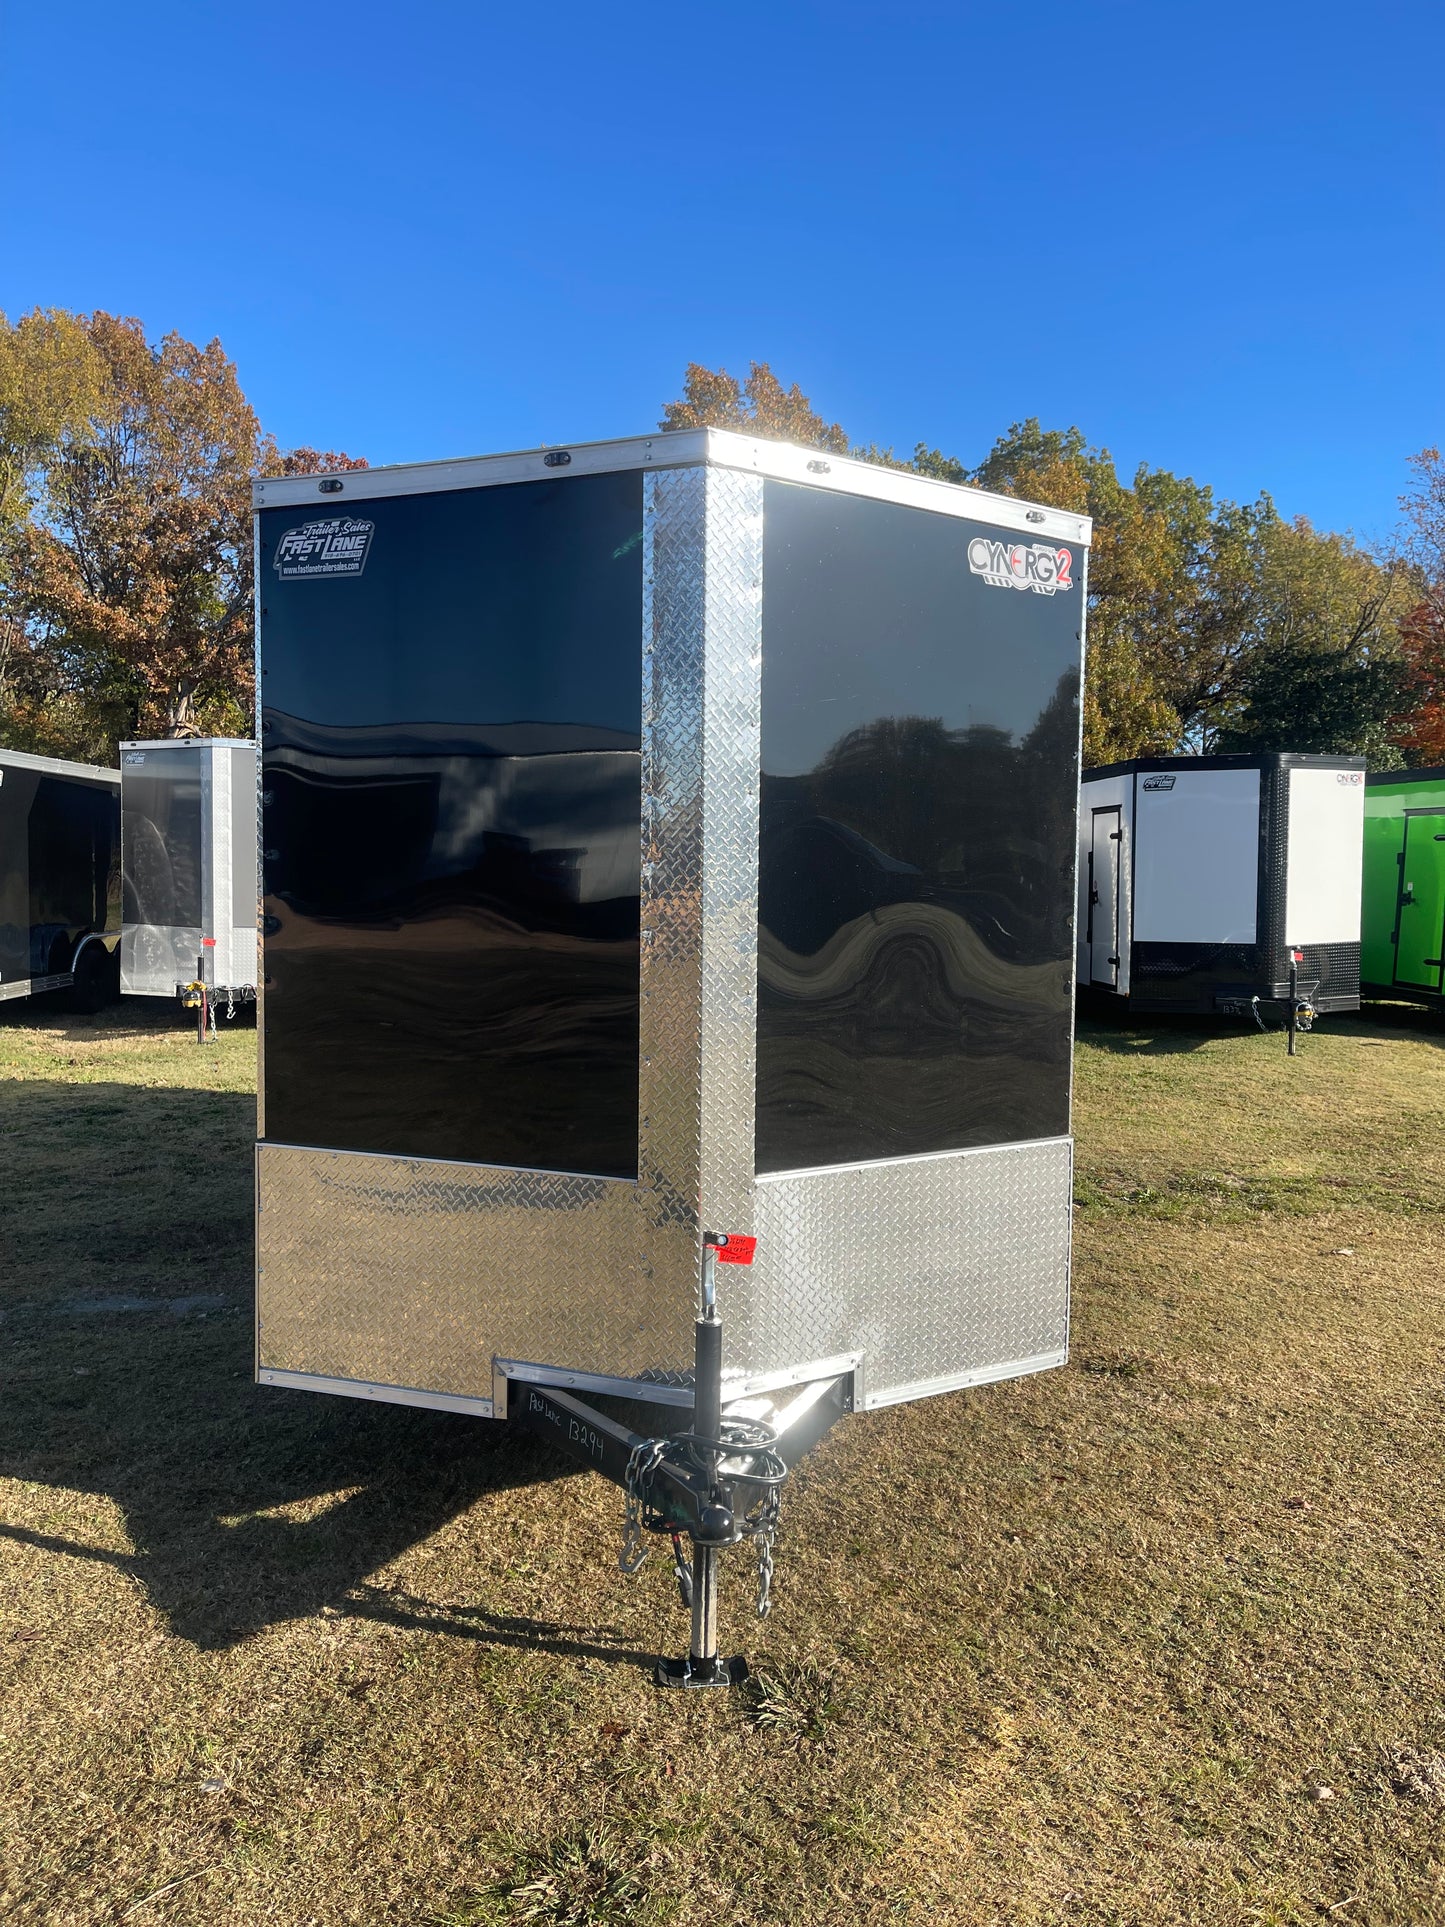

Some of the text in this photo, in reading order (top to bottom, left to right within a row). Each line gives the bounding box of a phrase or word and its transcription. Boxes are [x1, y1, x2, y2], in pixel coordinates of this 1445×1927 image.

[305, 522, 371, 537] Trailer Sales
[283, 562, 360, 575] www.fastlanetrailersales.com
[568, 1418, 604, 1460] 13294
